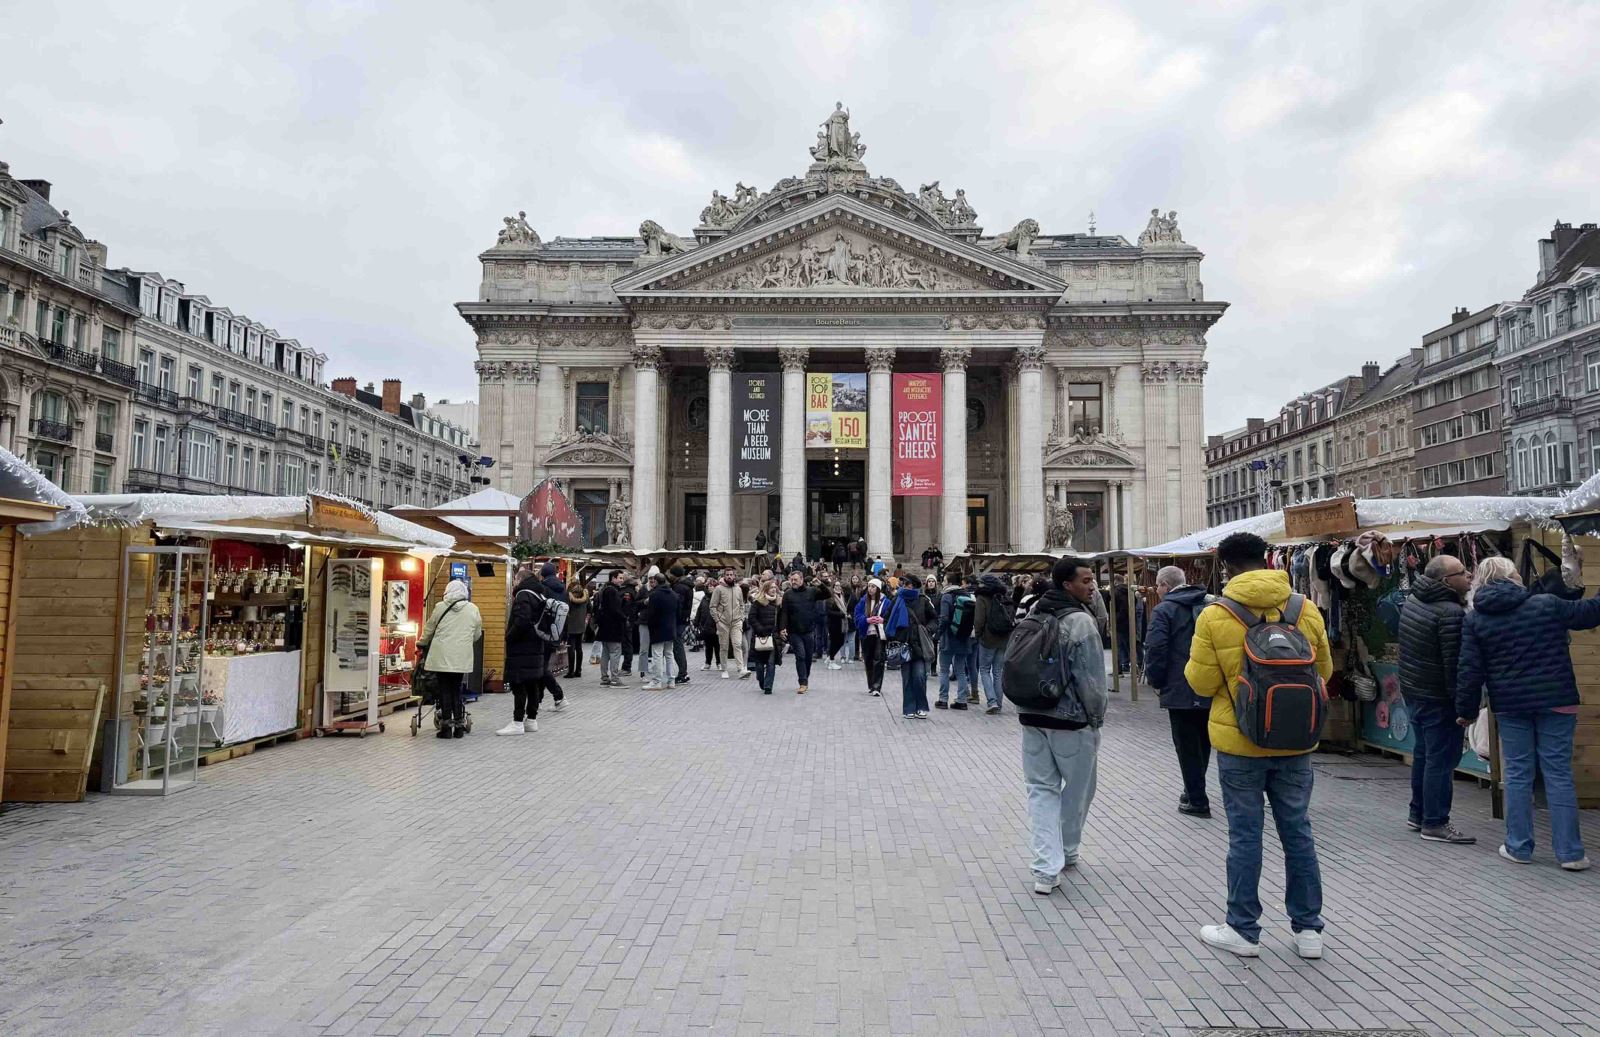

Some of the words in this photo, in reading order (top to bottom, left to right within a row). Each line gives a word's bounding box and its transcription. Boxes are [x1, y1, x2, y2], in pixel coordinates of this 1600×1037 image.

[811, 384, 828, 394] TOP
[811, 394, 828, 409] BAR
[743, 409, 770, 422] MORE
[898, 411, 937, 423] PROOST
[747, 422, 766, 434] THAN
[838, 417, 860, 437] 150
[743, 435, 749, 447] A
[750, 435, 769, 447] BEER
[741, 448, 771, 460] MUSEUM
[898, 442, 937, 459] CHEERS
